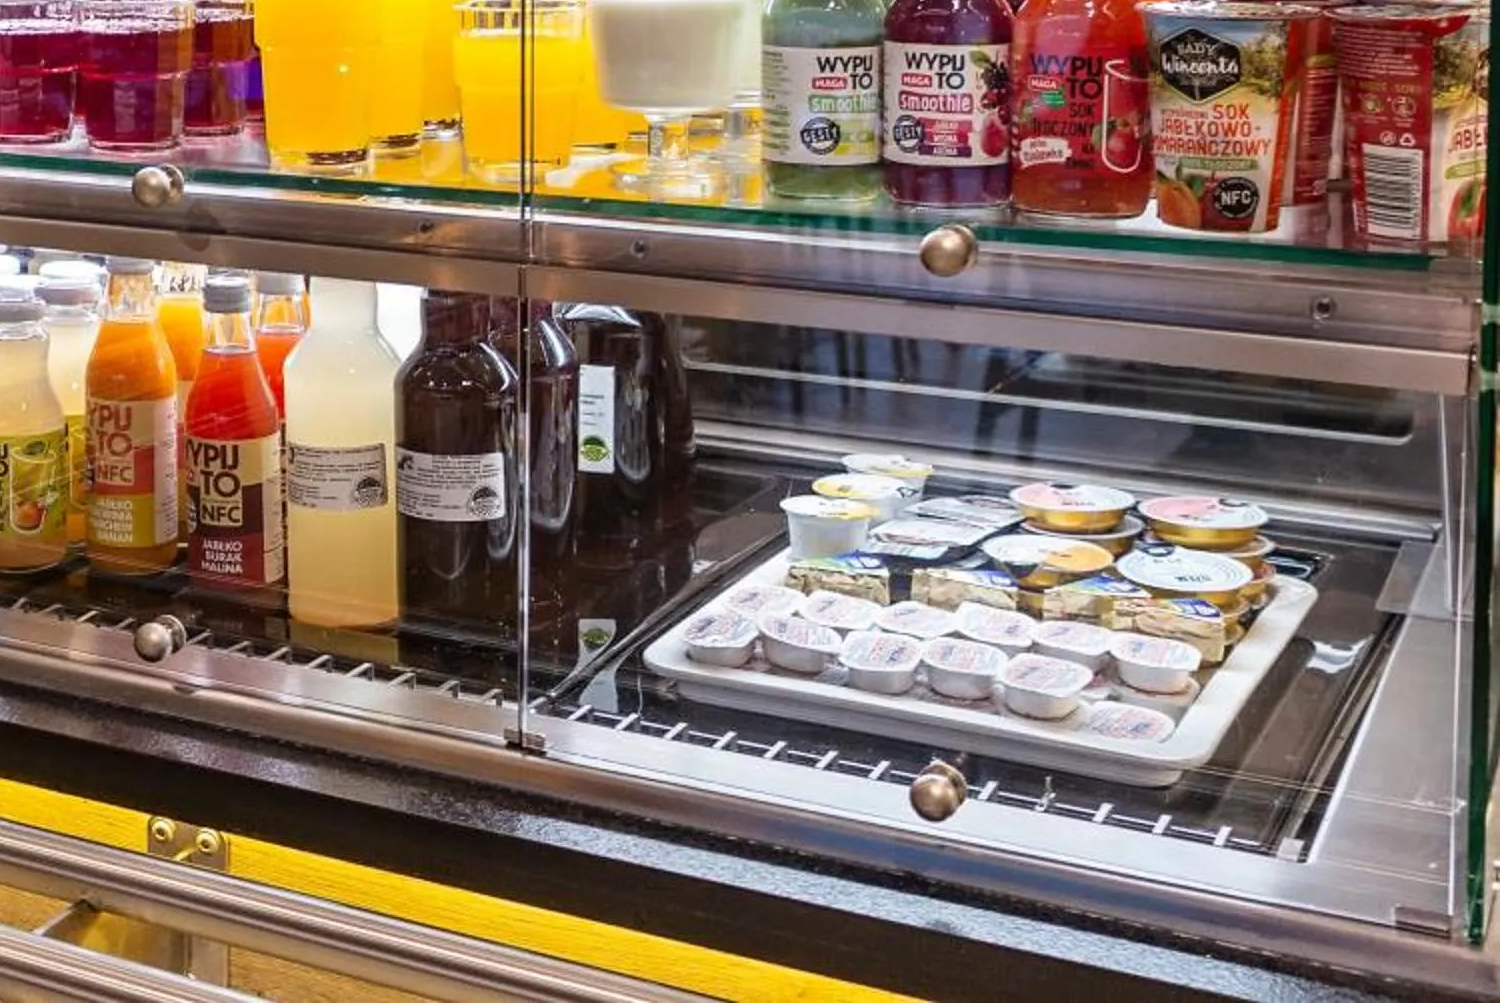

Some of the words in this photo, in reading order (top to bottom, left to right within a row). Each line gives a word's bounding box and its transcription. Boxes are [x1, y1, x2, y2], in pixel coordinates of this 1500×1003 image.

[816, 54, 873, 73] WYPU
[905, 52, 965, 72] WYPU
[1029, 53, 1102, 77] WYPU
[849, 72, 873, 89] TO
[935, 72, 965, 89] TO
[1065, 77, 1102, 100] TO
[900, 92, 971, 112] smoothie
[1213, 103, 1249, 119] SOK
[1221, 190, 1251, 206] NFC
[88, 402, 132, 431] YPU
[96, 429, 132, 457] TO
[97, 464, 133, 483] NFC
[200, 469, 241, 497] TO
[202, 504, 241, 523] NFC
